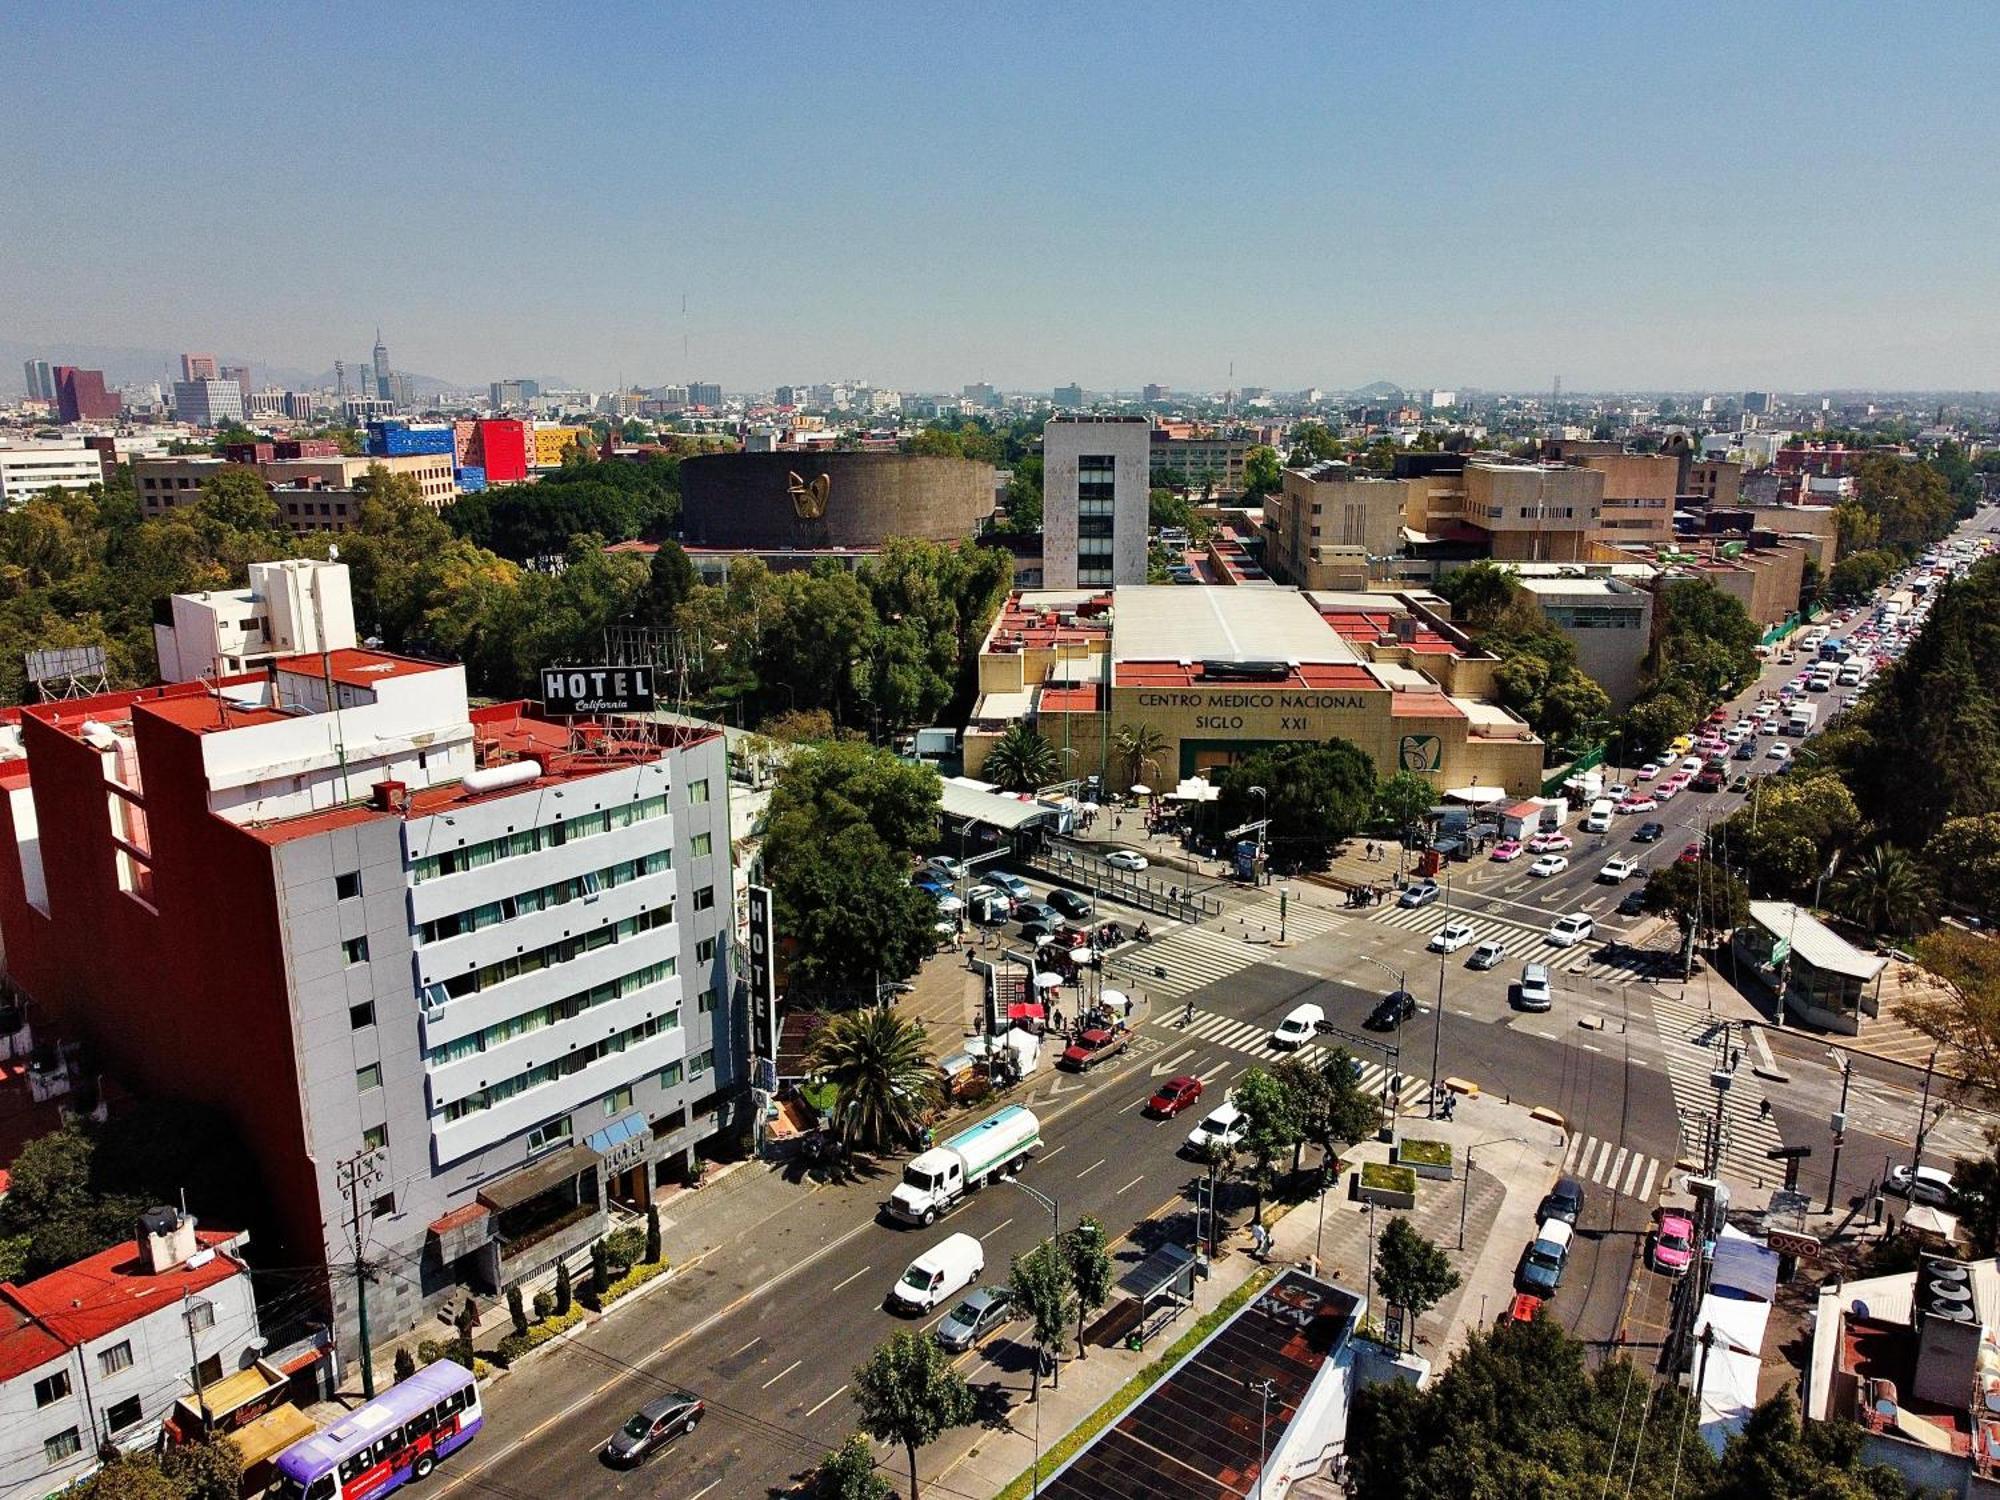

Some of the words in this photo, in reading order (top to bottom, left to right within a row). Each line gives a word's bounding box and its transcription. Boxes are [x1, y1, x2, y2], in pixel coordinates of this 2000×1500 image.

[546, 671, 649, 698] HOTEL
[575, 699, 628, 712] California
[1138, 693, 1201, 707] CENTRO
[1207, 694, 1274, 708] MEDICO
[1280, 695, 1366, 709] NACIONAL
[1195, 716, 1244, 729] SIGLO
[1280, 717, 1307, 730] XXI
[751, 901, 765, 1049] HOTEL
[1769, 1235, 1817, 1255] OXXO
